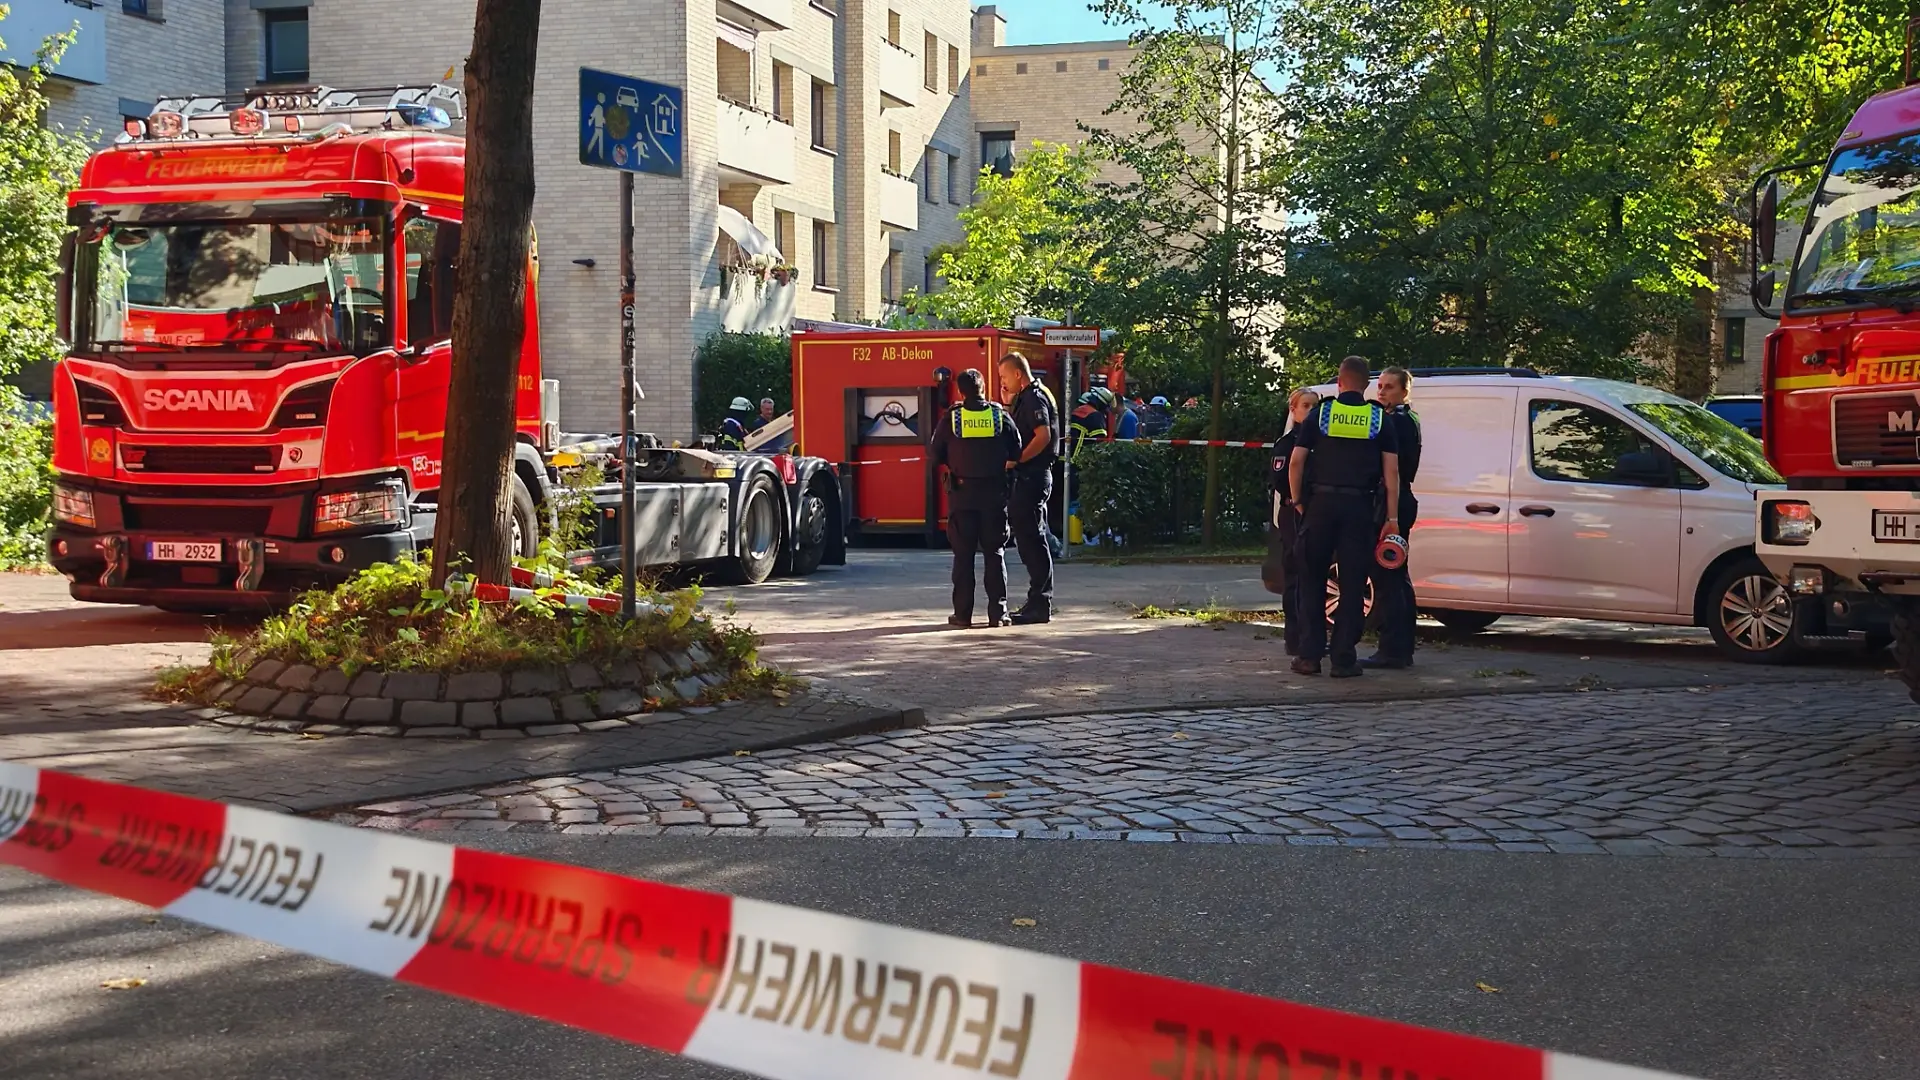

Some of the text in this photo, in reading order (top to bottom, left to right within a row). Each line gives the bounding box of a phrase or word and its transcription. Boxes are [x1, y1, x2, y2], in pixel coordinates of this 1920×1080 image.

[146, 157, 288, 179] FEUERWEHR
[1045, 333, 1096, 342] Feuerwehrzufahrt
[853, 345, 933, 361] F32 AB-Dekon
[143, 388, 255, 412] SCANIA
[964, 419, 992, 429] POLIZEI
[1332, 413, 1369, 427] POLIZEI
[1888, 410, 1920, 432] M
[1884, 516, 1906, 537] HH
[158, 544, 216, 560] HH 2932
[368, 866, 644, 986] SPERRZONE
[685, 928, 1035, 1080] FEUERWEHR
